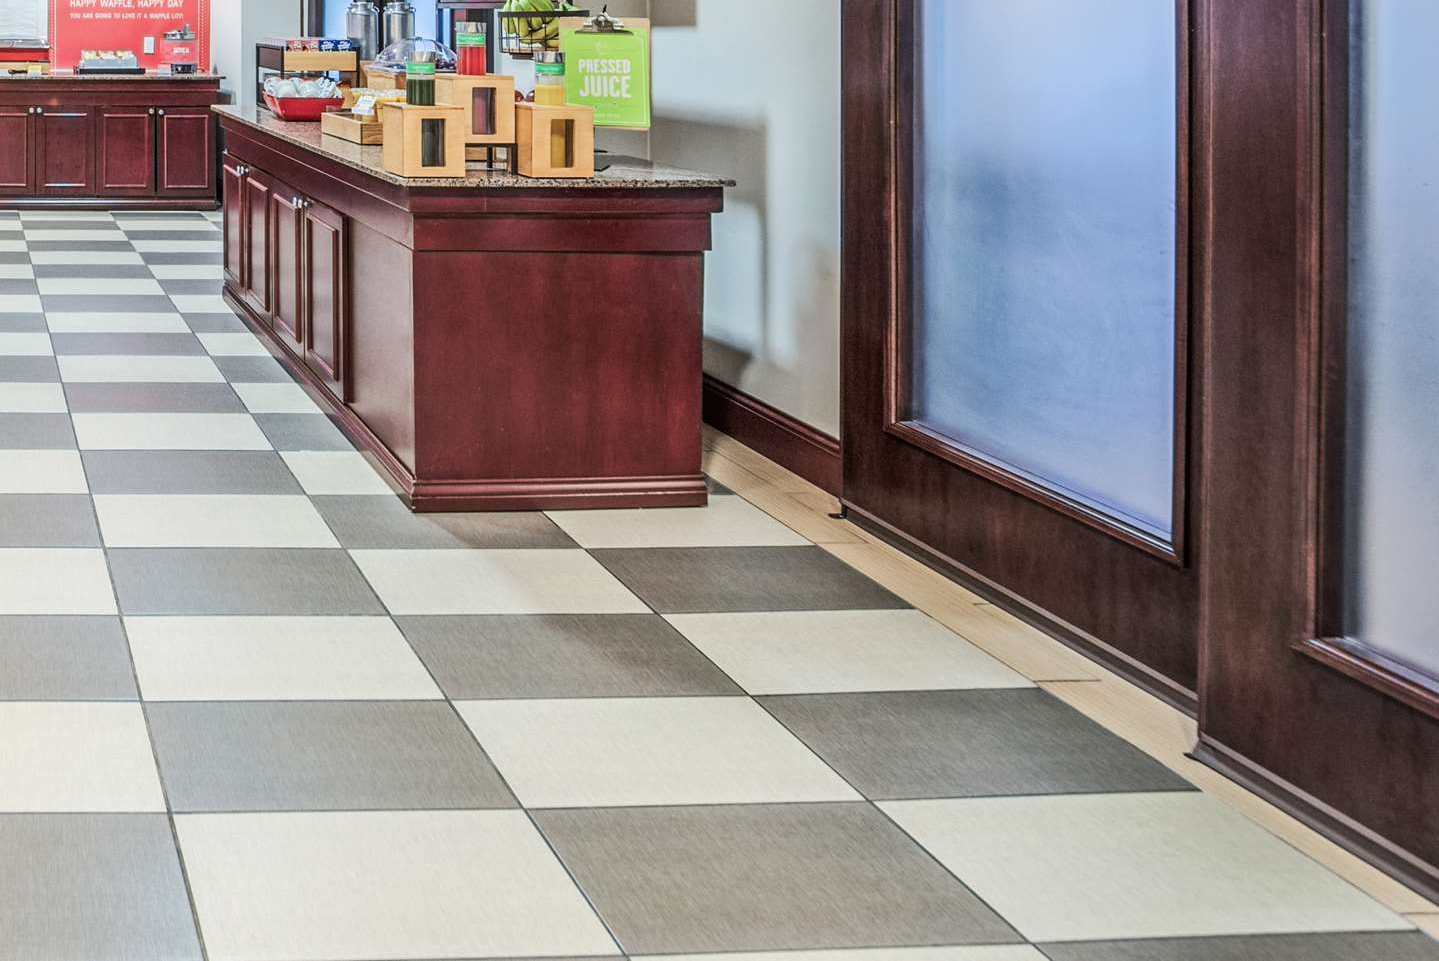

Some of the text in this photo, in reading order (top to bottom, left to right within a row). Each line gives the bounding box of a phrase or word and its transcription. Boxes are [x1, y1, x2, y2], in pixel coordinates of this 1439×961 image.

[70, 0, 184, 9] HAPPY WAFFLE, HAPPY DAY
[577, 58, 632, 74] PRESSED
[578, 75, 633, 99] JUICE
